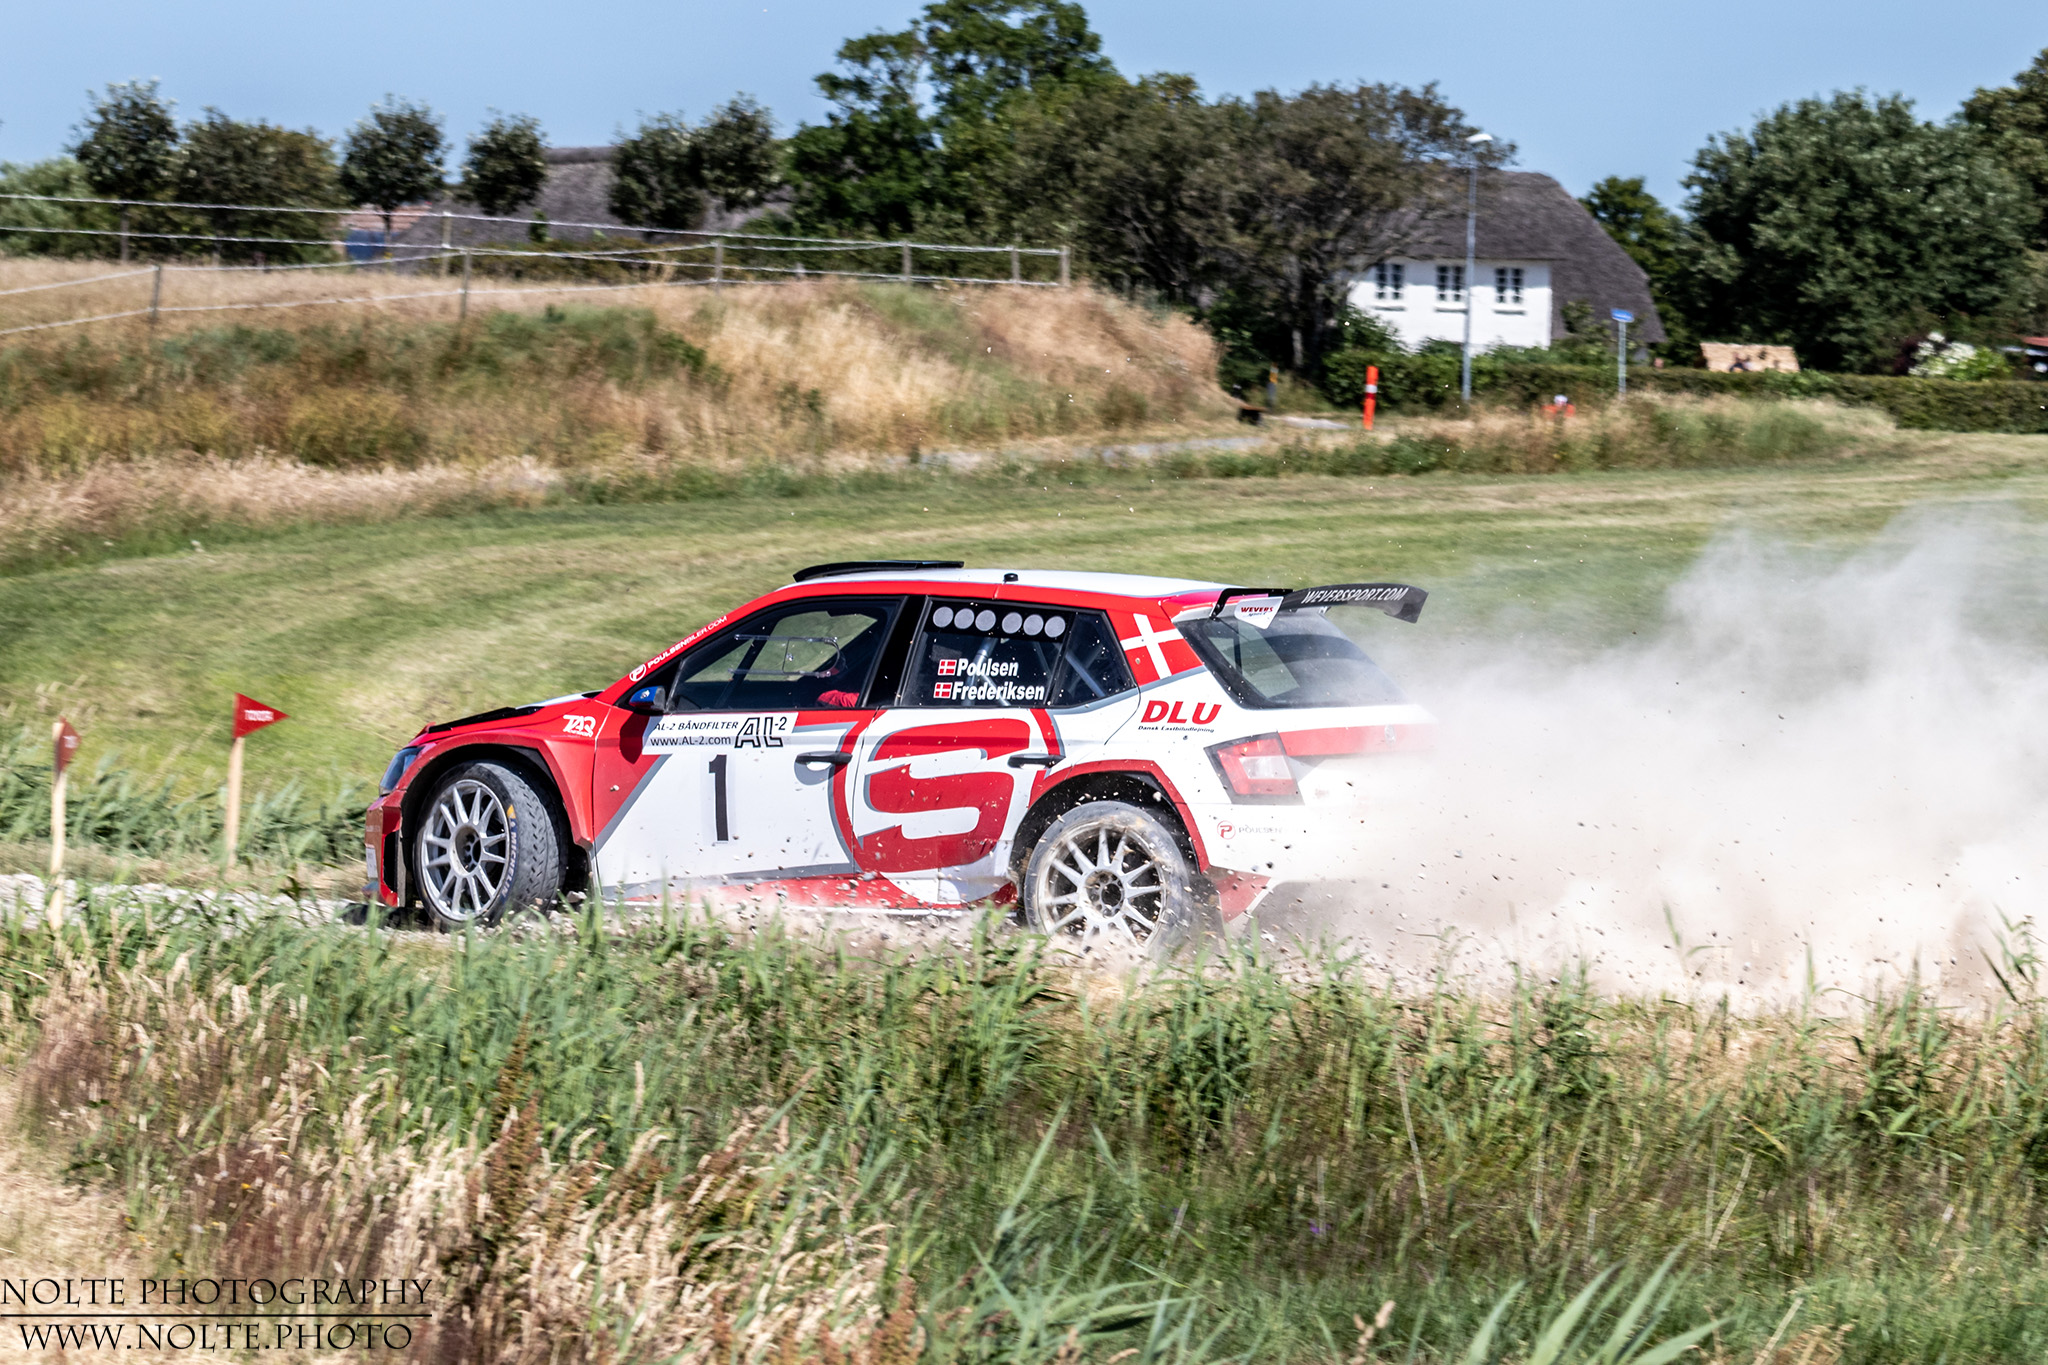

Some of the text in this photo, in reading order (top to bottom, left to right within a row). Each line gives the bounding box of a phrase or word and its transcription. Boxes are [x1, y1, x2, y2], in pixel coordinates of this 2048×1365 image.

[1301, 587, 1409, 604] WEVERSSPORT.COM
[956, 658, 1019, 677] Poulsen
[952, 681, 1045, 700] Frederiksen
[1140, 700, 1222, 724] DLU
[654, 719, 739, 732] AL-2 BÅNDFILTER
[650, 735, 732, 746] www.AL-2.com
[708, 754, 729, 842] 1
[501, 831, 518, 897] MICHELIN
